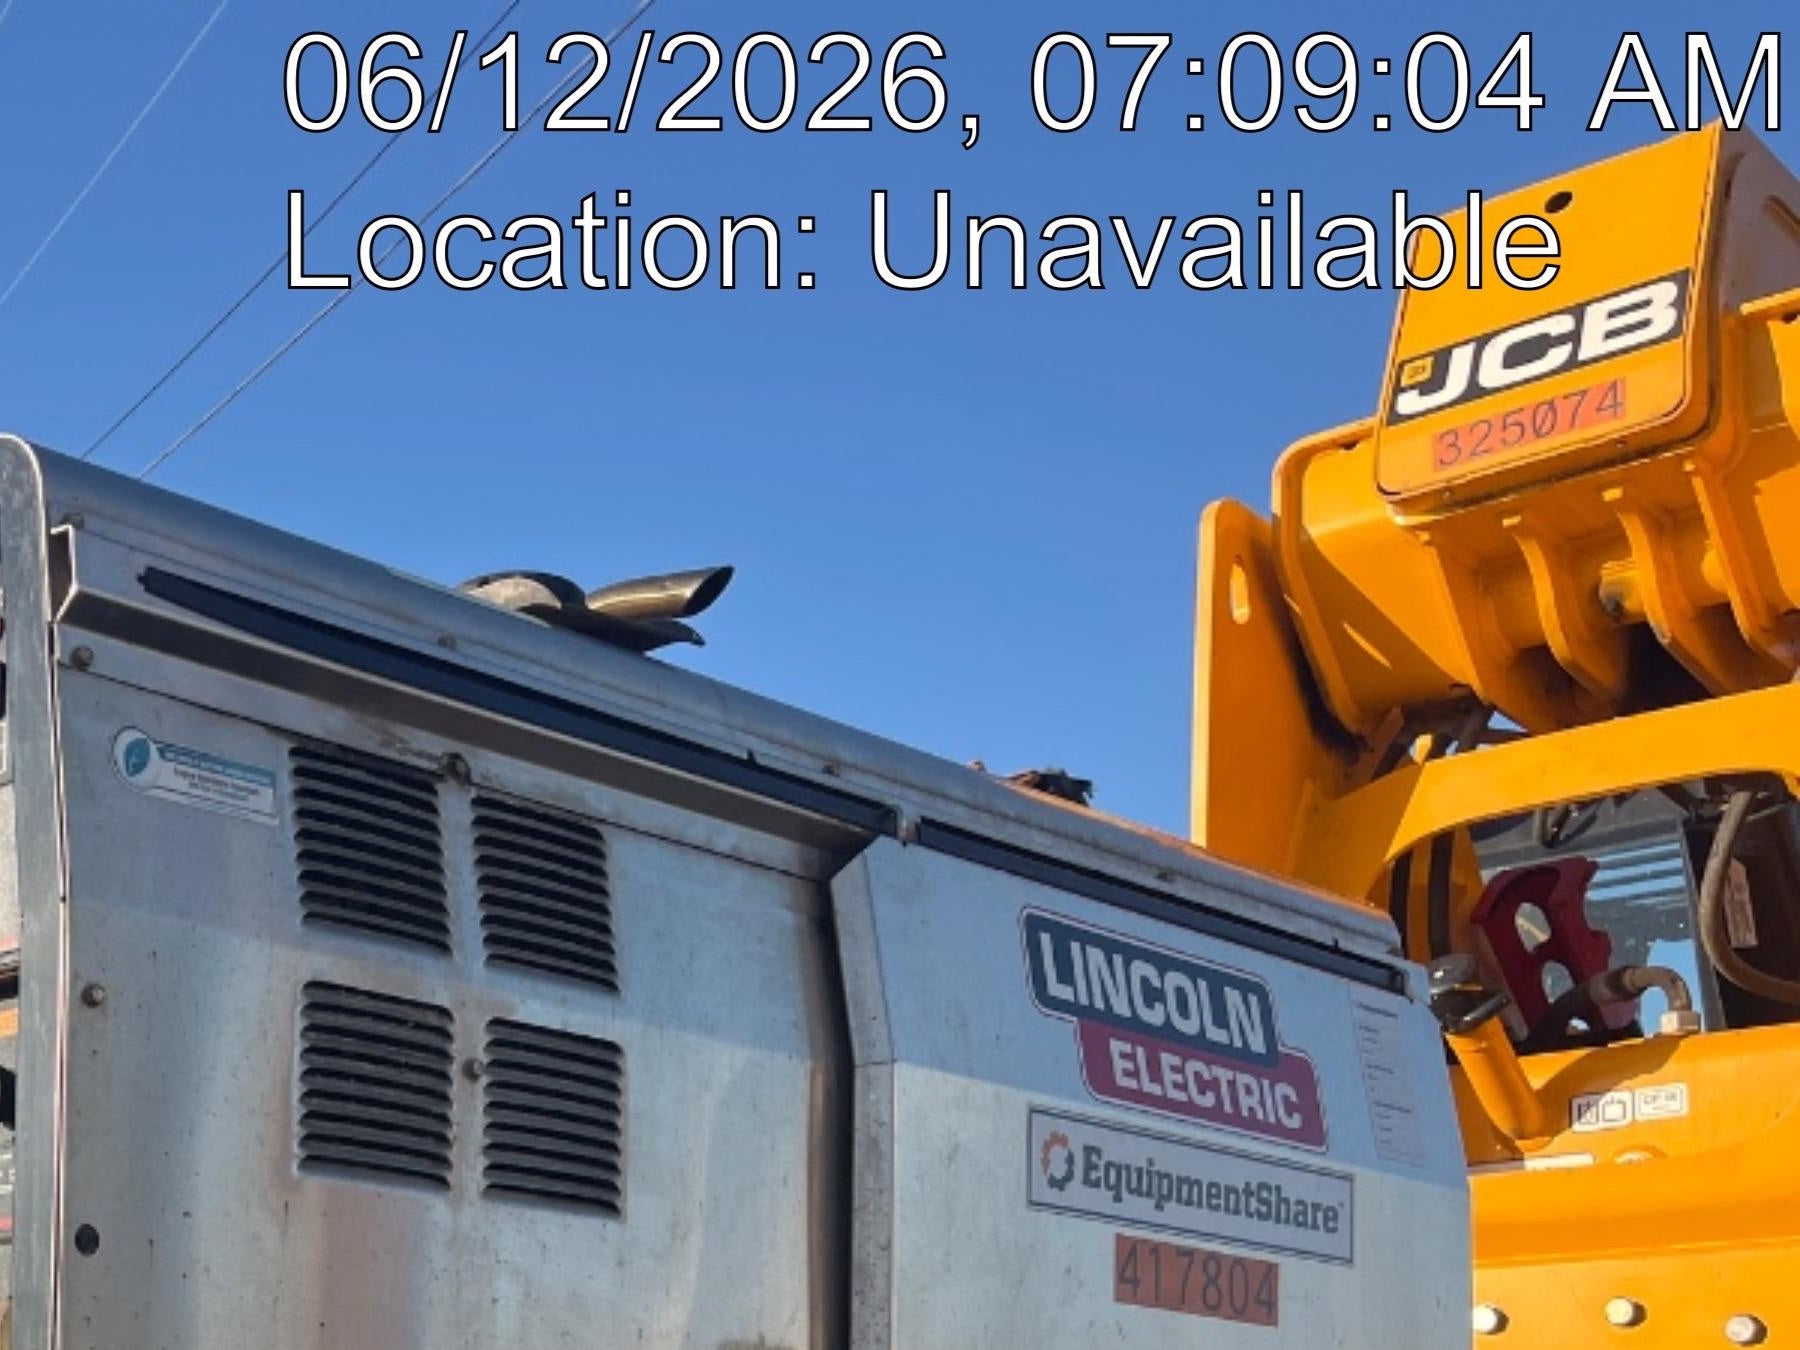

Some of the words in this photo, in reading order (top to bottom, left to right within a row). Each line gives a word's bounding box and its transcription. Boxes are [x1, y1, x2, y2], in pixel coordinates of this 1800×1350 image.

[1396, 280, 1679, 416] JCB
[1438, 380, 1624, 467] 325074
[1039, 931, 1267, 1054] LINCOLN
[1109, 1037, 1303, 1129] ELECTRIC
[1081, 1144, 1340, 1233] EquipmentShare
[1118, 1239, 1274, 1318] 417804
